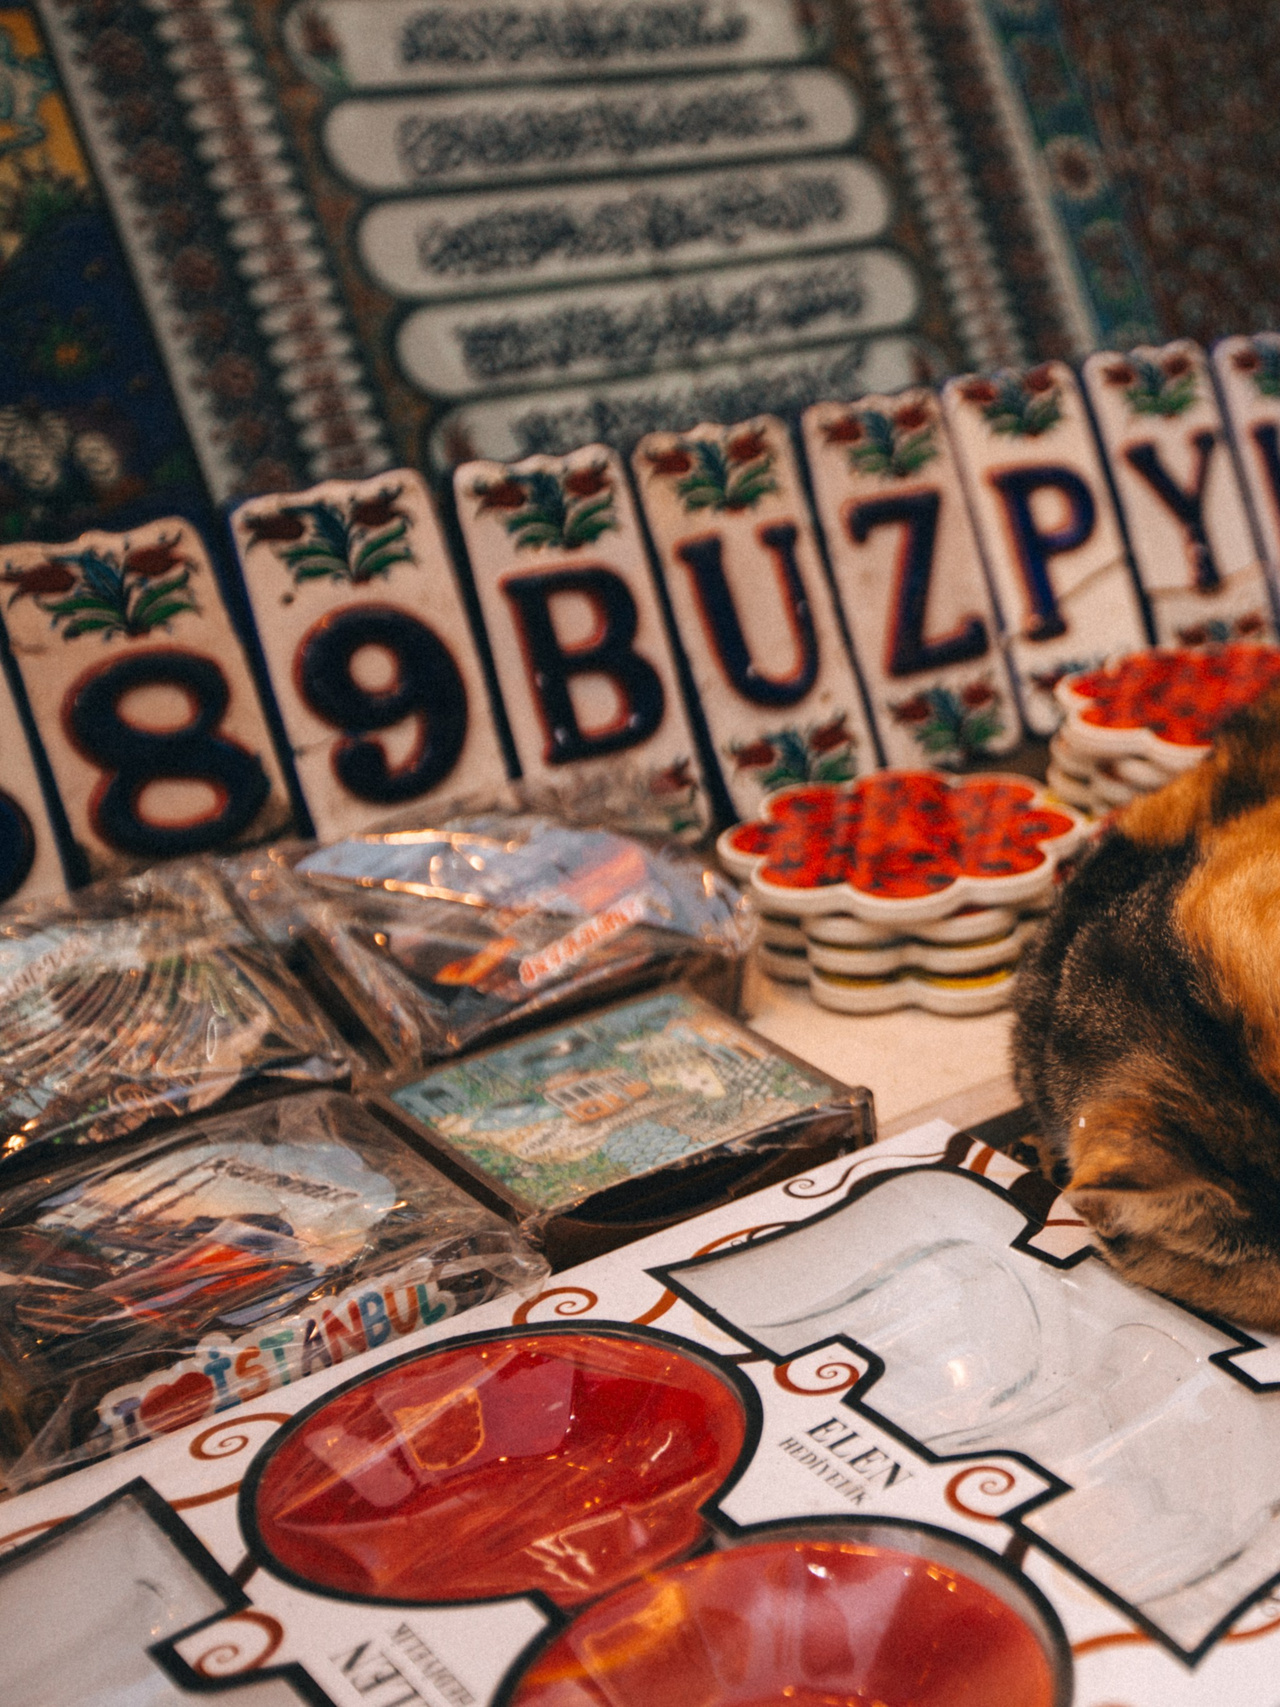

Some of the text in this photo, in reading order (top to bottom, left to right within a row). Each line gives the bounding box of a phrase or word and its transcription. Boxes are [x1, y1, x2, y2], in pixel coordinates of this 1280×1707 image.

[845, 489, 990, 680] Z
[987, 463, 1097, 643] P
[1124, 430, 1228, 595] Y
[291, 603, 469, 806] 9
[498, 564, 666, 766] B
[674, 522, 821, 709] U
[60, 644, 271, 857] 8
[804, 1416, 914, 1491] ELEN
